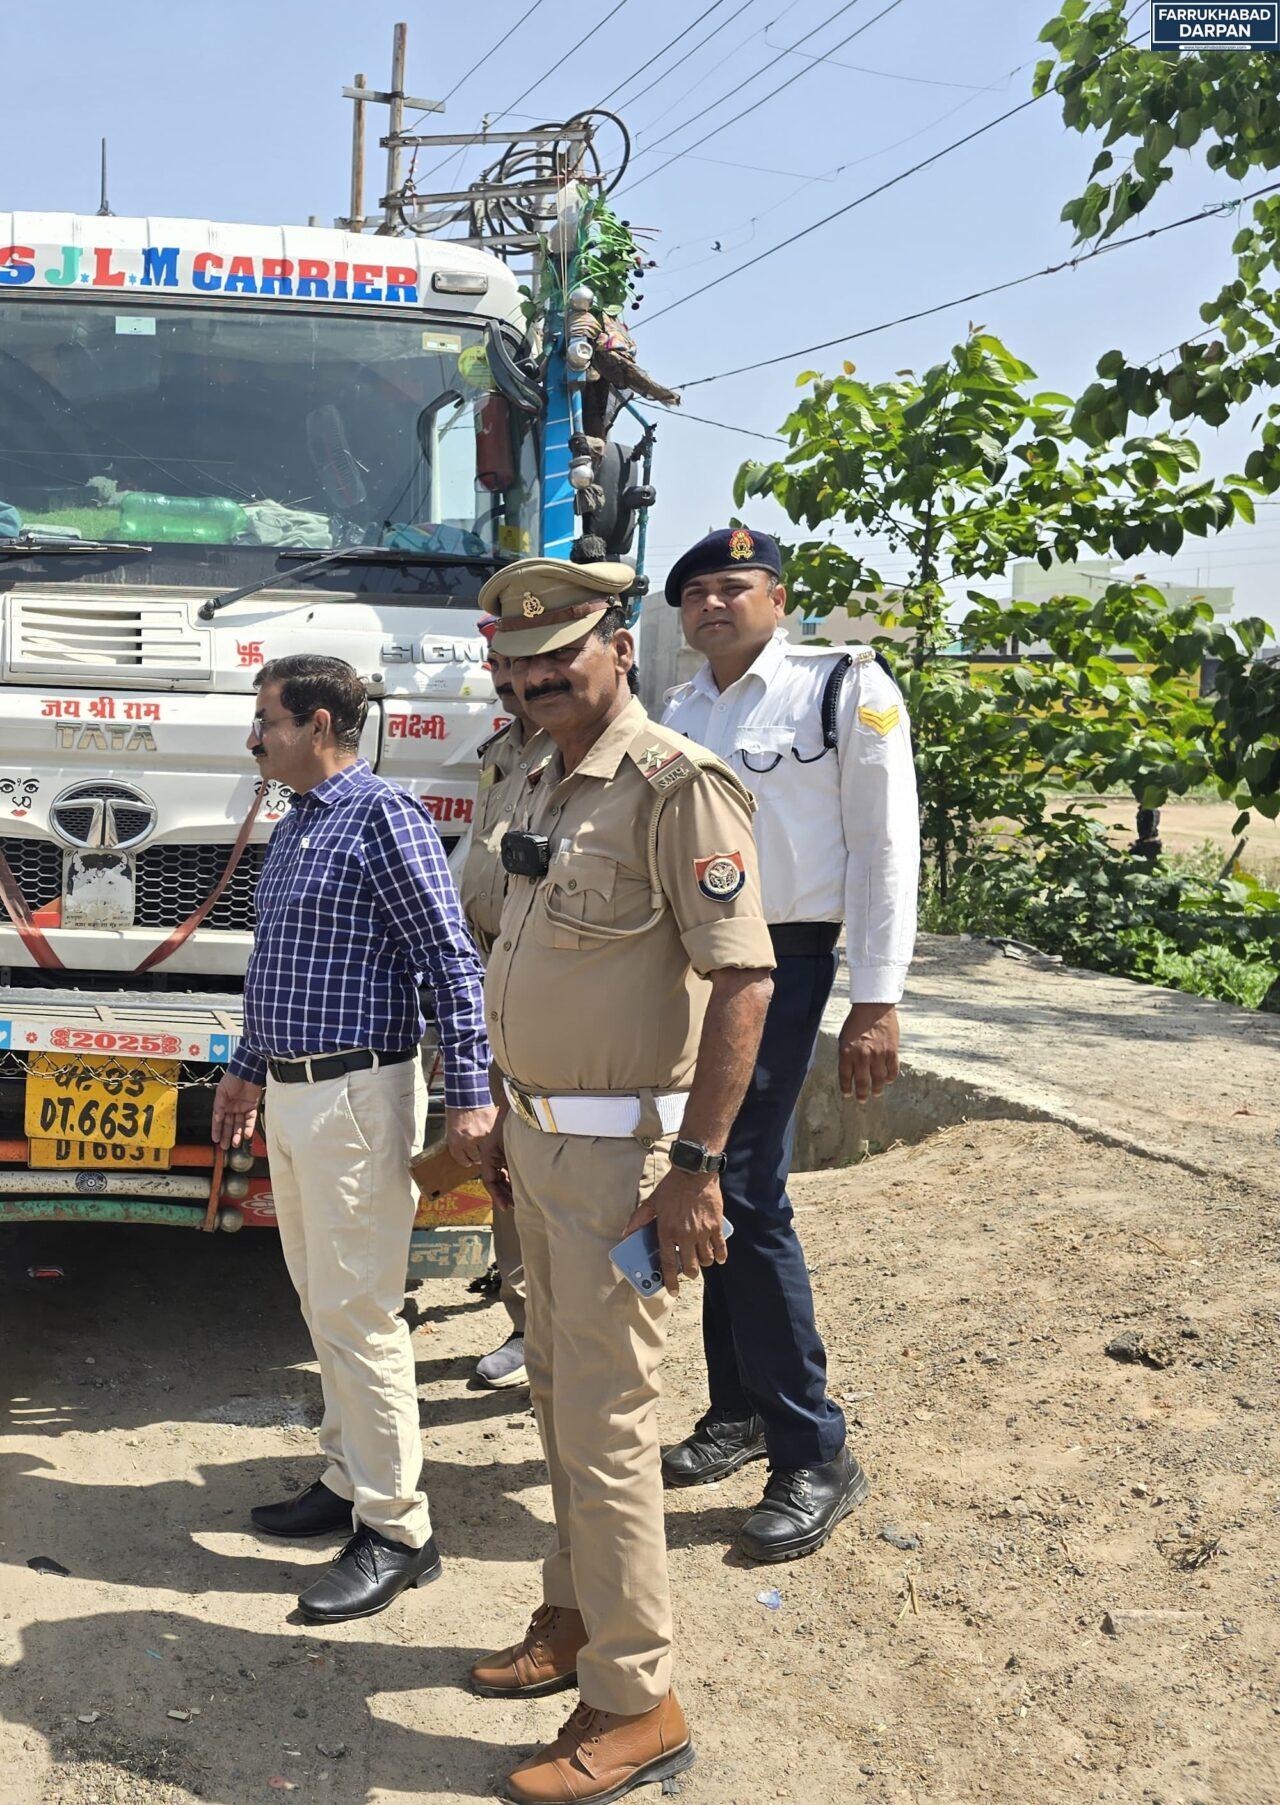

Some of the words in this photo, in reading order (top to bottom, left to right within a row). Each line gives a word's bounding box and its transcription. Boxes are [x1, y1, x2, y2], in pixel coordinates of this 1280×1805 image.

[192, 252, 419, 303] CARRIER
[380, 634, 489, 664] SIGN
[40, 699, 81, 718] जय
[88, 696, 116, 719] श्री
[123, 702, 161, 721] राम
[55, 721, 158, 752] TATA
[387, 714, 446, 741] लक्ष्मी
[72, 1031, 162, 1054] 2025
[40, 1097, 155, 1140] DT.6631
